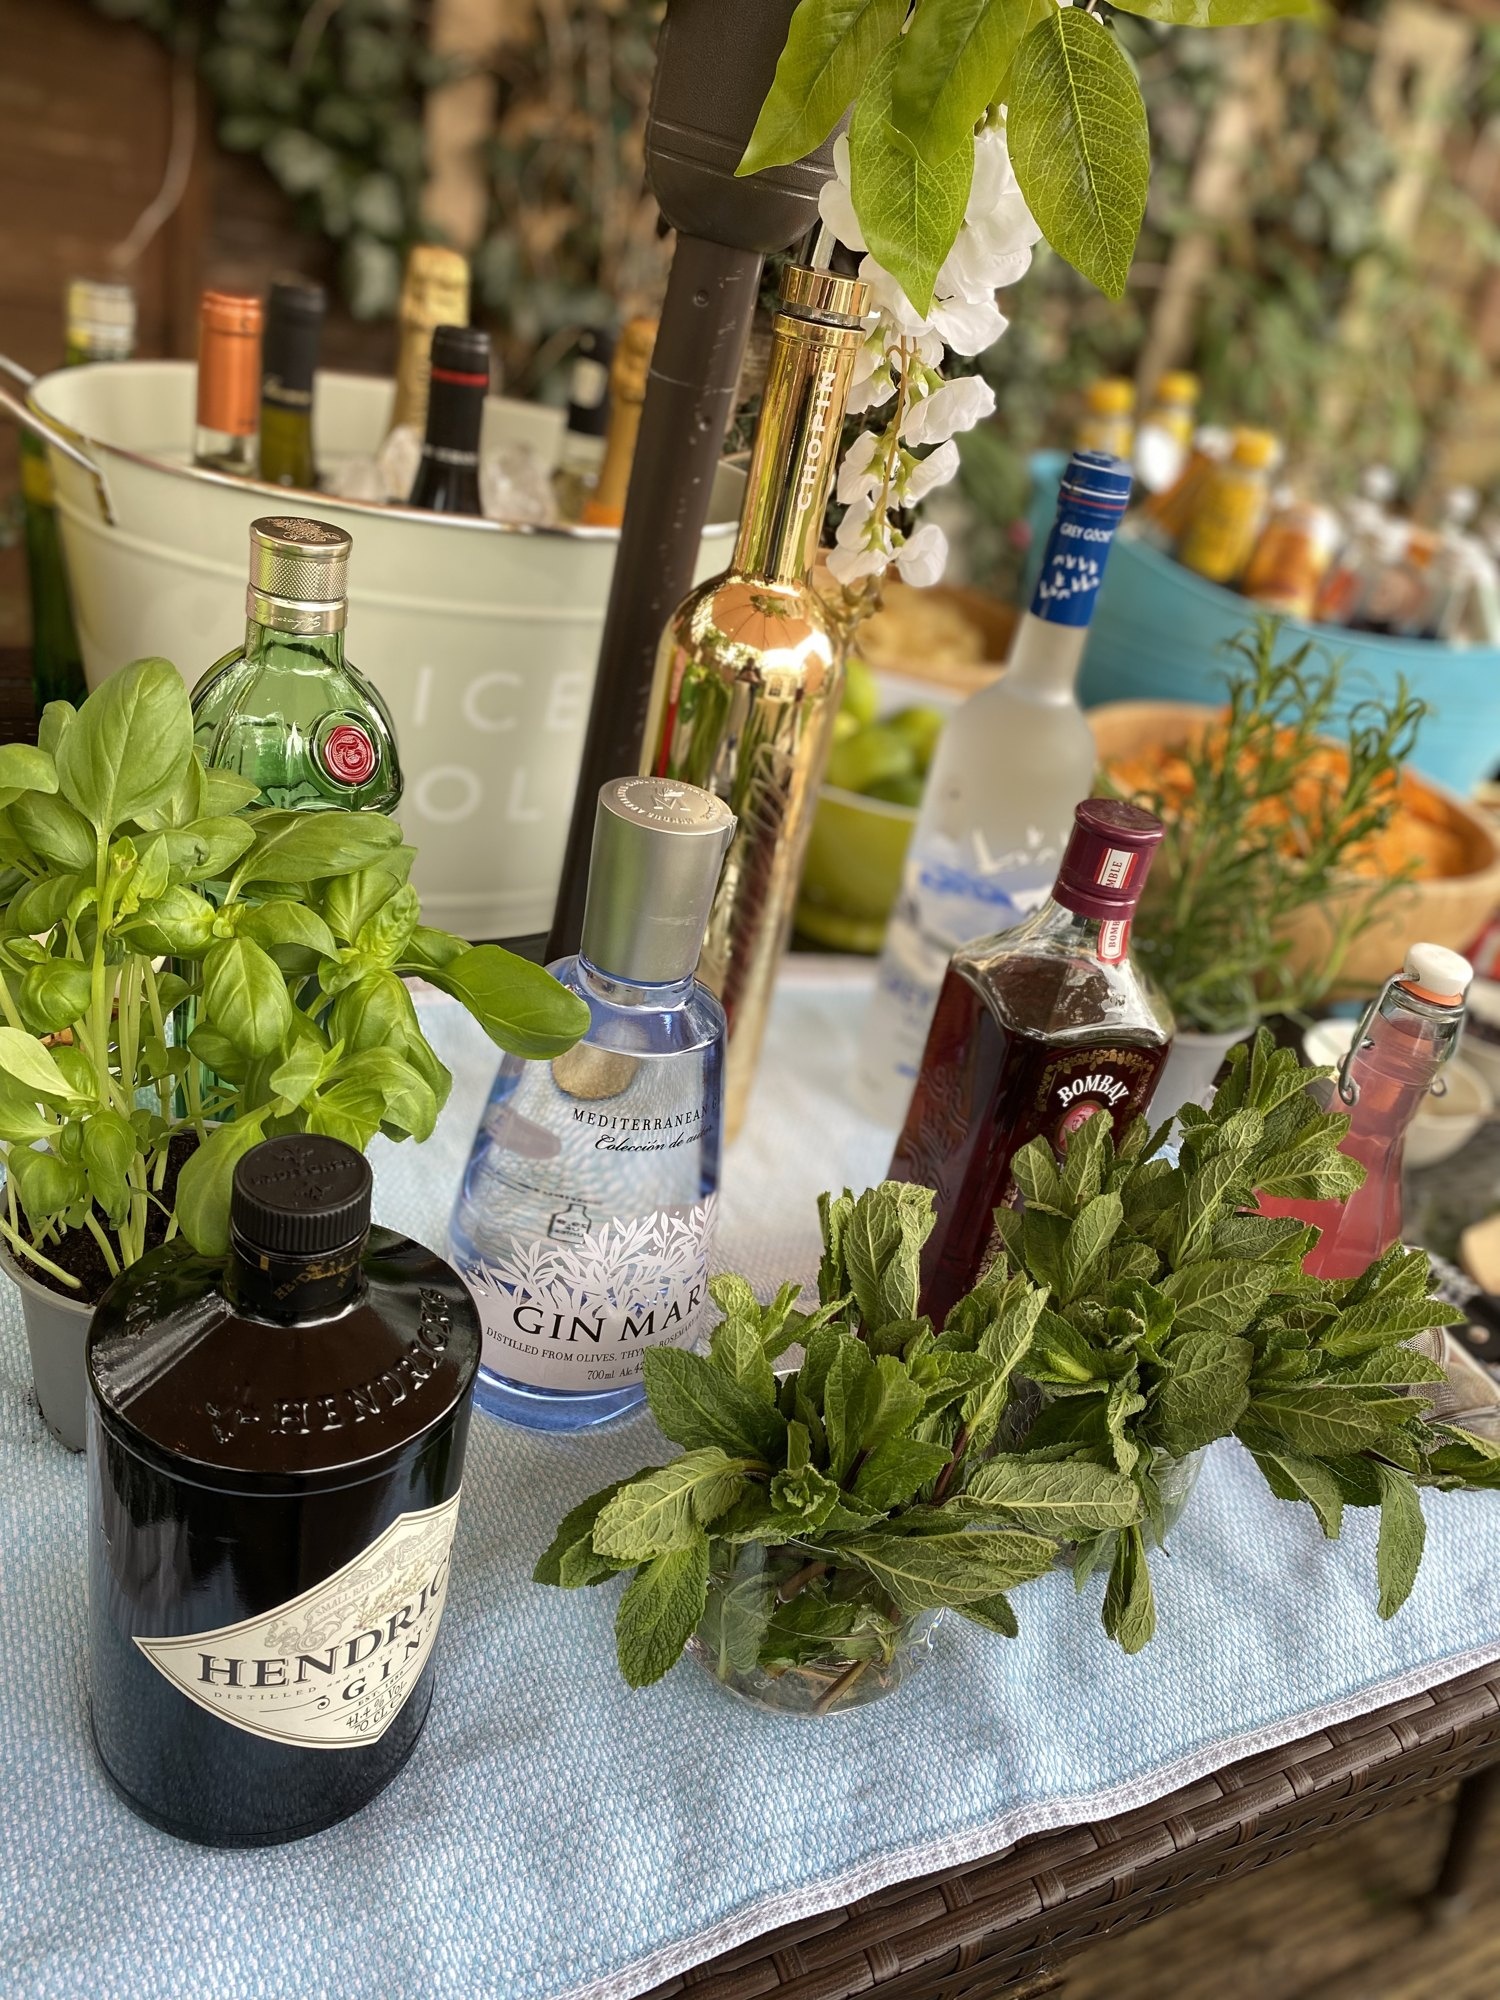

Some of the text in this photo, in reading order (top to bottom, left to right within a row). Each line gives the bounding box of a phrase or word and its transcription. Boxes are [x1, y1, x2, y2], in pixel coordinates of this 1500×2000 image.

[797, 372, 836, 511] CHOPIN
[411, 666, 588, 732] ICE
[413, 763, 545, 824] OL
[1057, 1073, 1130, 1108] BOMBAY
[572, 1103, 708, 1131] MEDITERRANEAN
[594, 1134, 665, 1152] Colección
[668, 1131, 685, 1149] de
[512, 1283, 702, 1343] GIN MAR
[486, 1326, 539, 1356] DISTILLED
[541, 1349, 573, 1362] FROM
[587, 1369, 615, 1381] 700ml
[197, 1549, 451, 1688] HENDRIC
[315, 1590, 351, 1618] SMALL
[342, 1629, 422, 1701] GIN
[213, 1686, 317, 1701] DISTILLED
